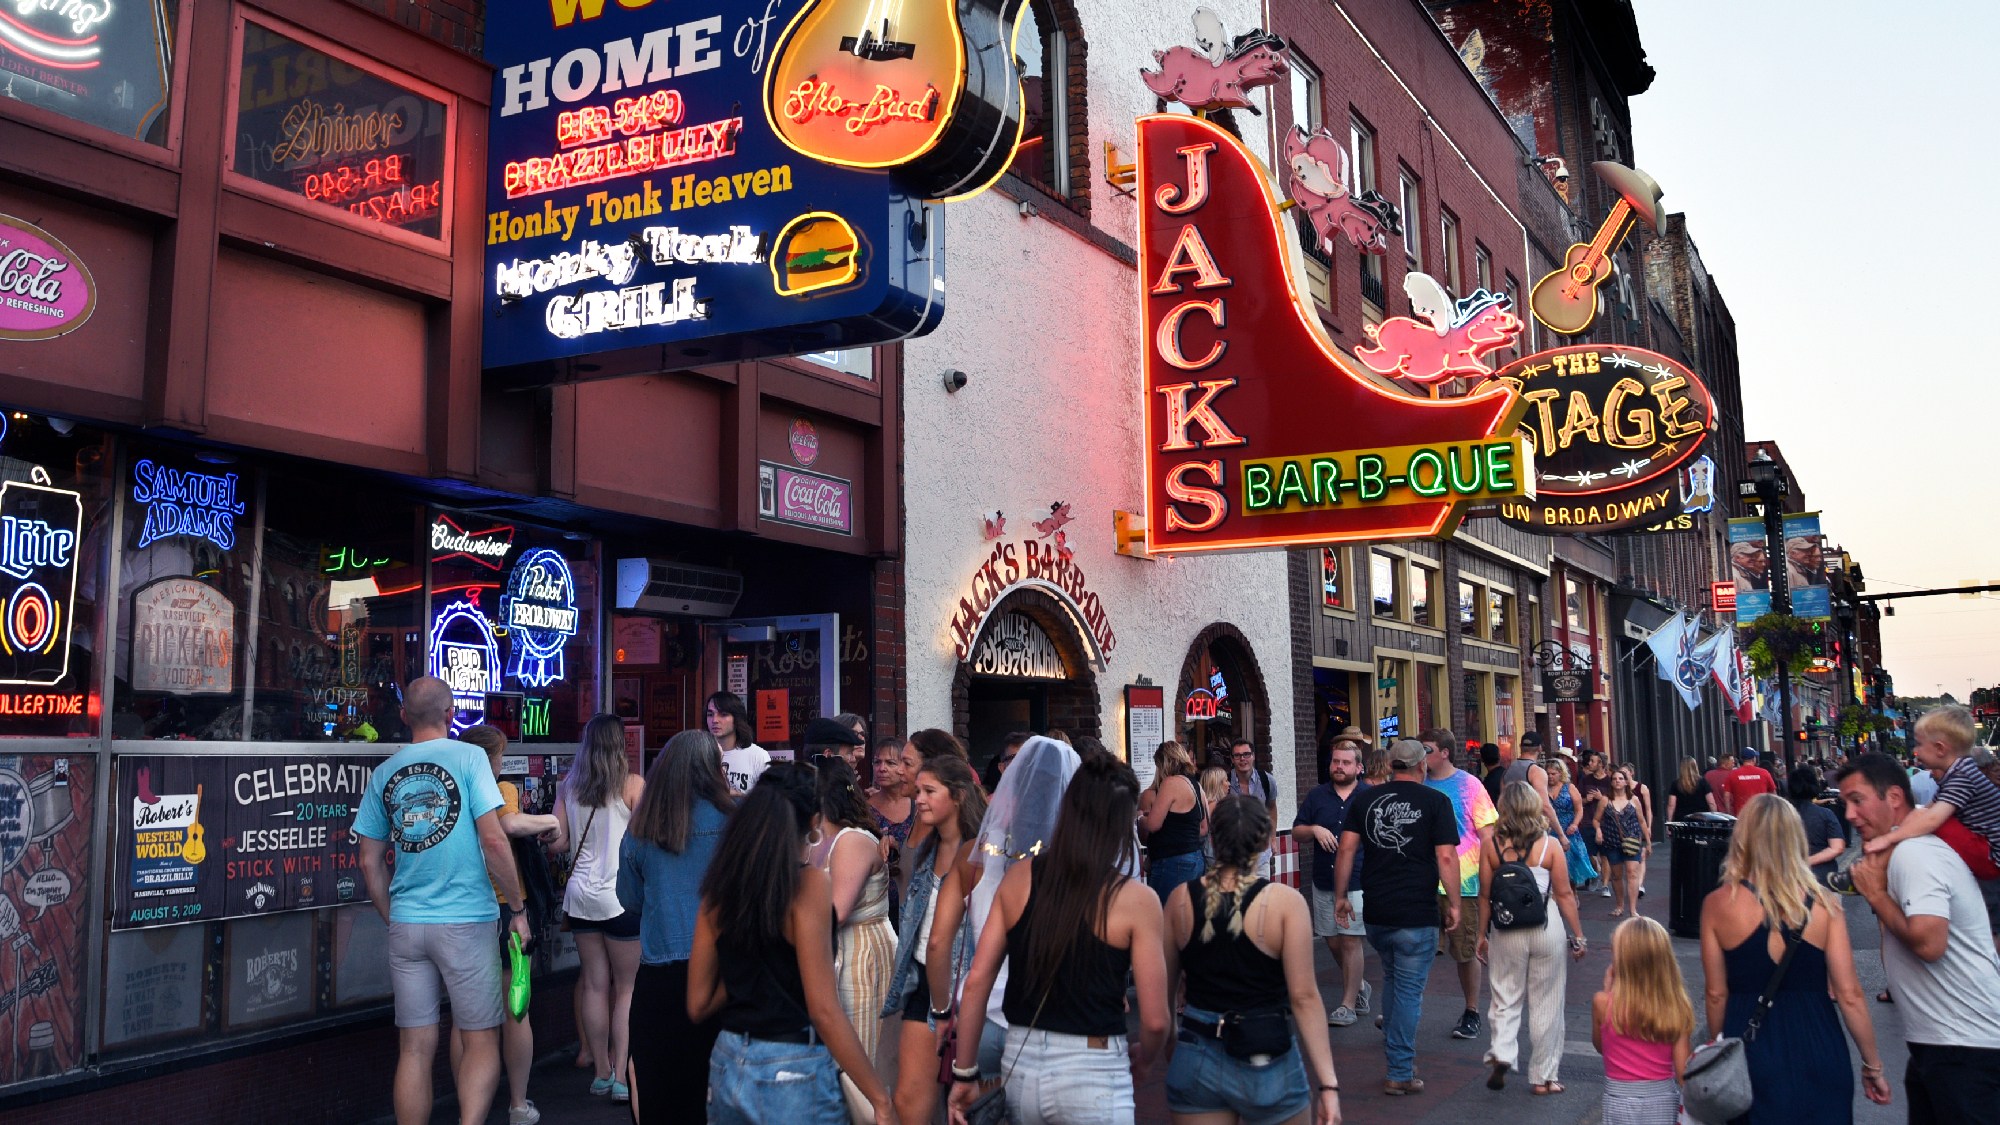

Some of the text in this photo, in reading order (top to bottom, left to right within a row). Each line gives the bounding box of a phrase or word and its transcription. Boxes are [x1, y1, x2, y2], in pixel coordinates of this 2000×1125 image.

[501, 0, 781, 117] HOME of
[785, 80, 937, 133] Sho-Bud
[272, 99, 403, 164] Shiner
[504, 117, 744, 199] BRAZILBILLY
[488, 164, 793, 246] Honky Tonk Heaven
[7, 298, 65, 318] REFRESHING
[545, 276, 707, 339] GRILL
[1151, 140, 1246, 535] JACKS
[1553, 352, 1600, 377] THE
[134, 460, 244, 514] SAMUEL
[1243, 440, 1517, 513] BAR-B-QUE
[785, 476, 843, 518] Coca-Cola
[1544, 488, 1670, 525] BROADWAY
[139, 501, 235, 550] ADAMS
[432, 523, 512, 557] Budweiser
[0, 515, 74, 579] Lite
[529, 564, 565, 602] Pabst
[147, 584, 222, 619] AMERICAN MADE
[162, 609, 207, 623] NASHVILLE
[514, 602, 575, 631] BROADWAY
[950, 541, 1020, 661] JACK'S
[141, 622, 229, 668] PICKERS
[448, 647, 481, 671] BUD
[997, 646, 1031, 677] 1976
[163, 667, 203, 686] VODKA
[441, 667, 488, 692] LIGHT
[1187, 697, 1217, 718] OPEN
[385, 764, 455, 802] OAK ISLAND
[136, 799, 193, 828] Robert's
[296, 803, 347, 821] 20 YEARS
[136, 830, 184, 844] WESTERN
[136, 842, 183, 859] WORLD
[237, 826, 327, 853] JESSEELEE
[144, 872, 194, 884] BRAZILBILLY
[227, 859, 274, 880] STICK
[283, 855, 322, 875] WITH
[134, 889, 165, 898] NASHVILLE,
[245, 885, 258, 899] JACK
[130, 903, 202, 922] AUGUST 5, 2019
[247, 948, 298, 984] ROBERT'S
